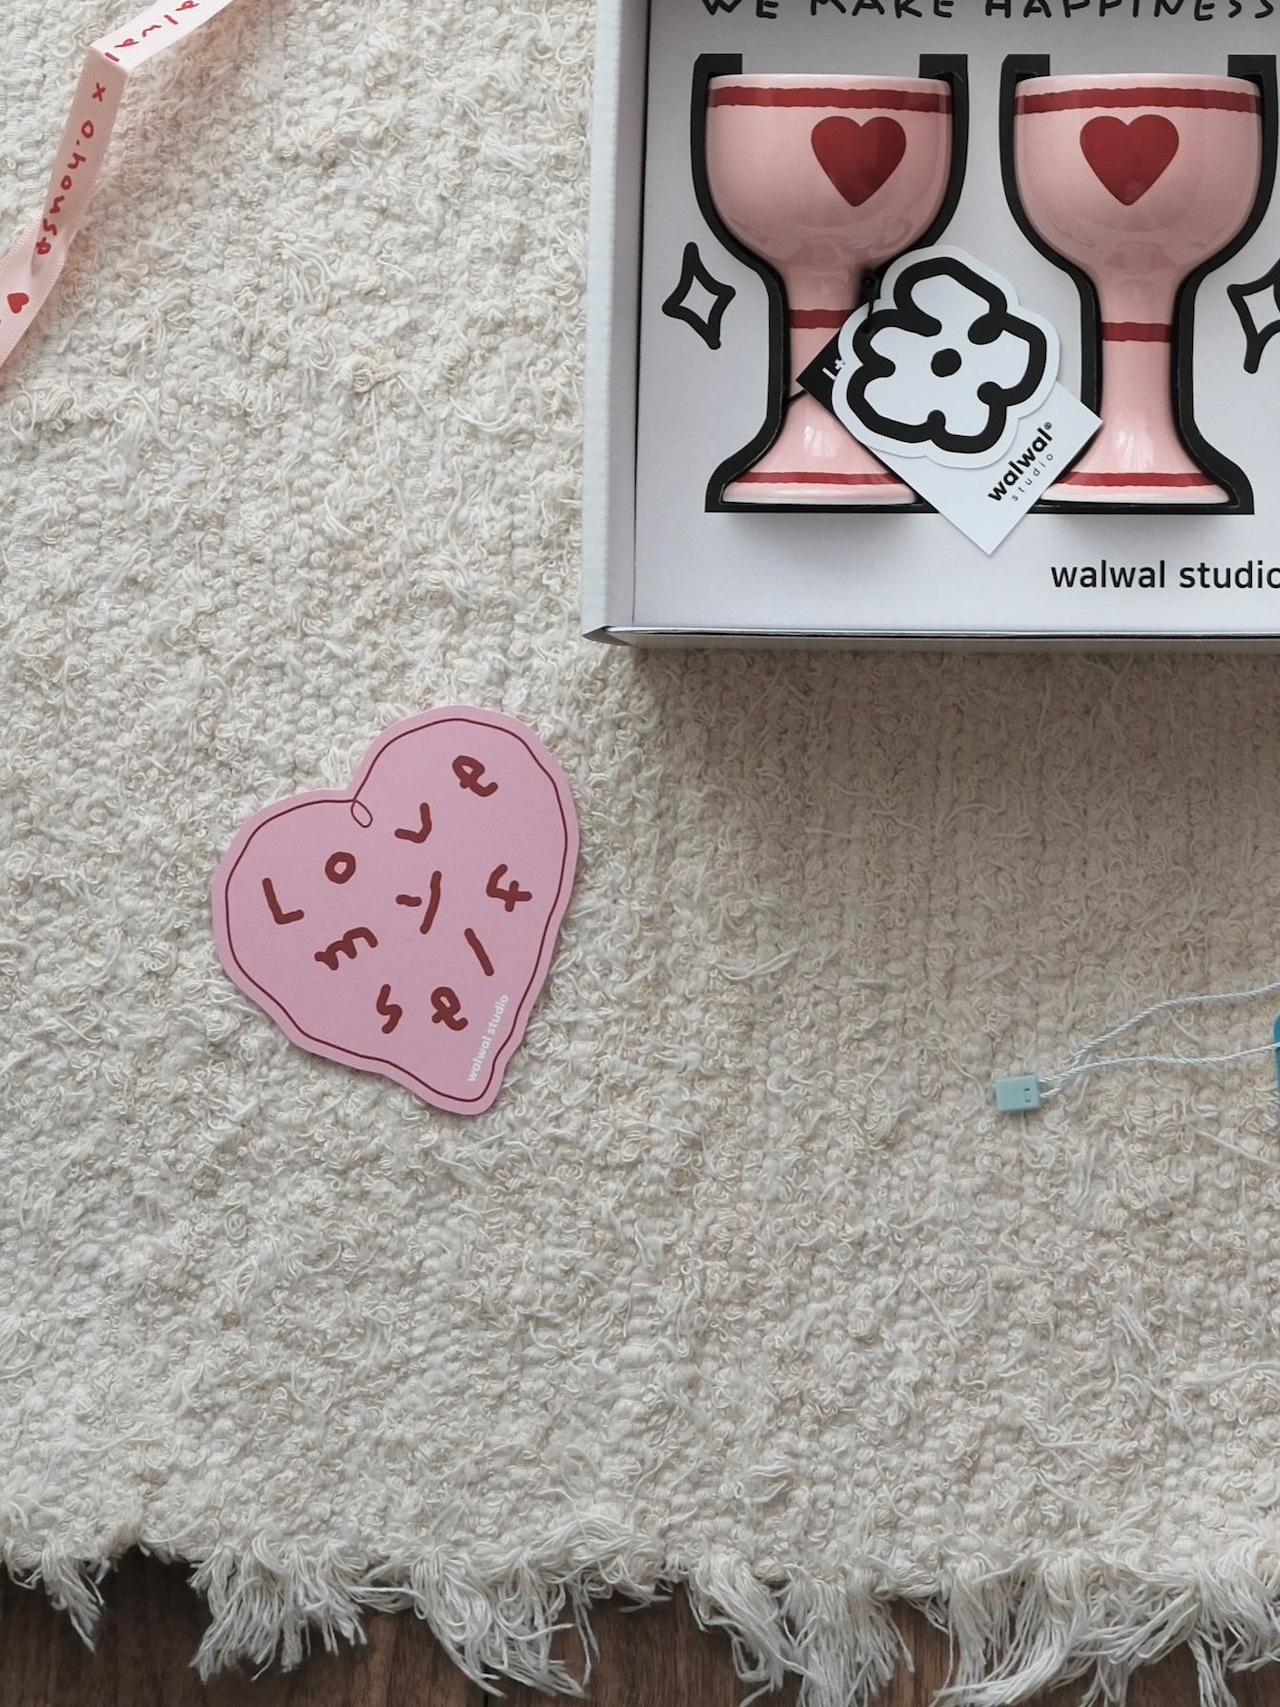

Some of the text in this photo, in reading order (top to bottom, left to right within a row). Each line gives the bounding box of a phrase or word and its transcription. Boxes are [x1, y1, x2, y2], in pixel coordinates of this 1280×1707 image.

[1012, 454, 1053, 501] studio
[1051, 560, 1167, 590] walwal
[467, 994, 509, 1082] walwal studio
